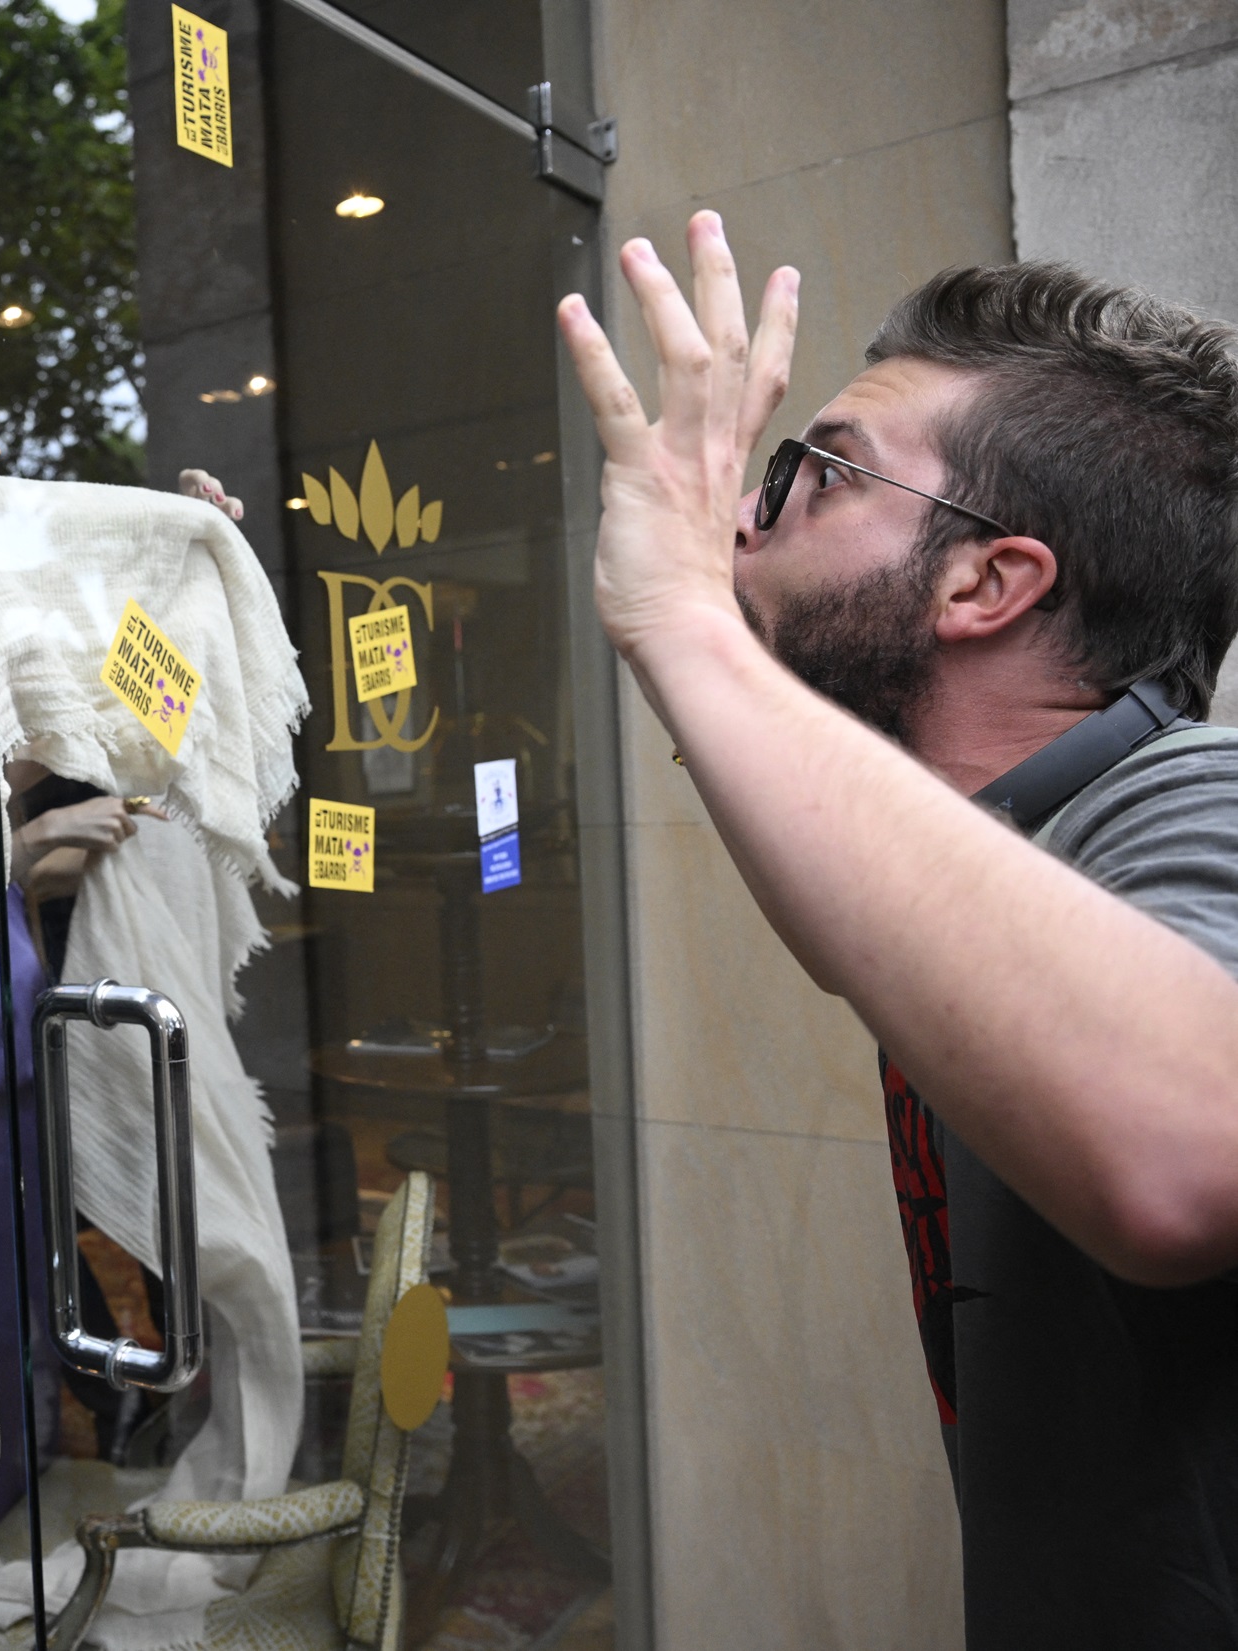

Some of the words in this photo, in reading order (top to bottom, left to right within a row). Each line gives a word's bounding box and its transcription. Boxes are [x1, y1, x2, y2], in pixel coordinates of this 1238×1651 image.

[179, 20, 195, 125] TURISME
[199, 87, 213, 149] MATA
[214, 86, 227, 146] BARRIS
[361, 615, 406, 643] TURISME
[117, 636, 155, 689] MATA
[127, 615, 139, 633] EL
[137, 620, 194, 696] TURISME
[358, 646, 386, 669] MATA
[114, 667, 152, 716] BARRIS
[315, 835, 344, 856] MATA
[323, 810, 369, 834] TURISME
